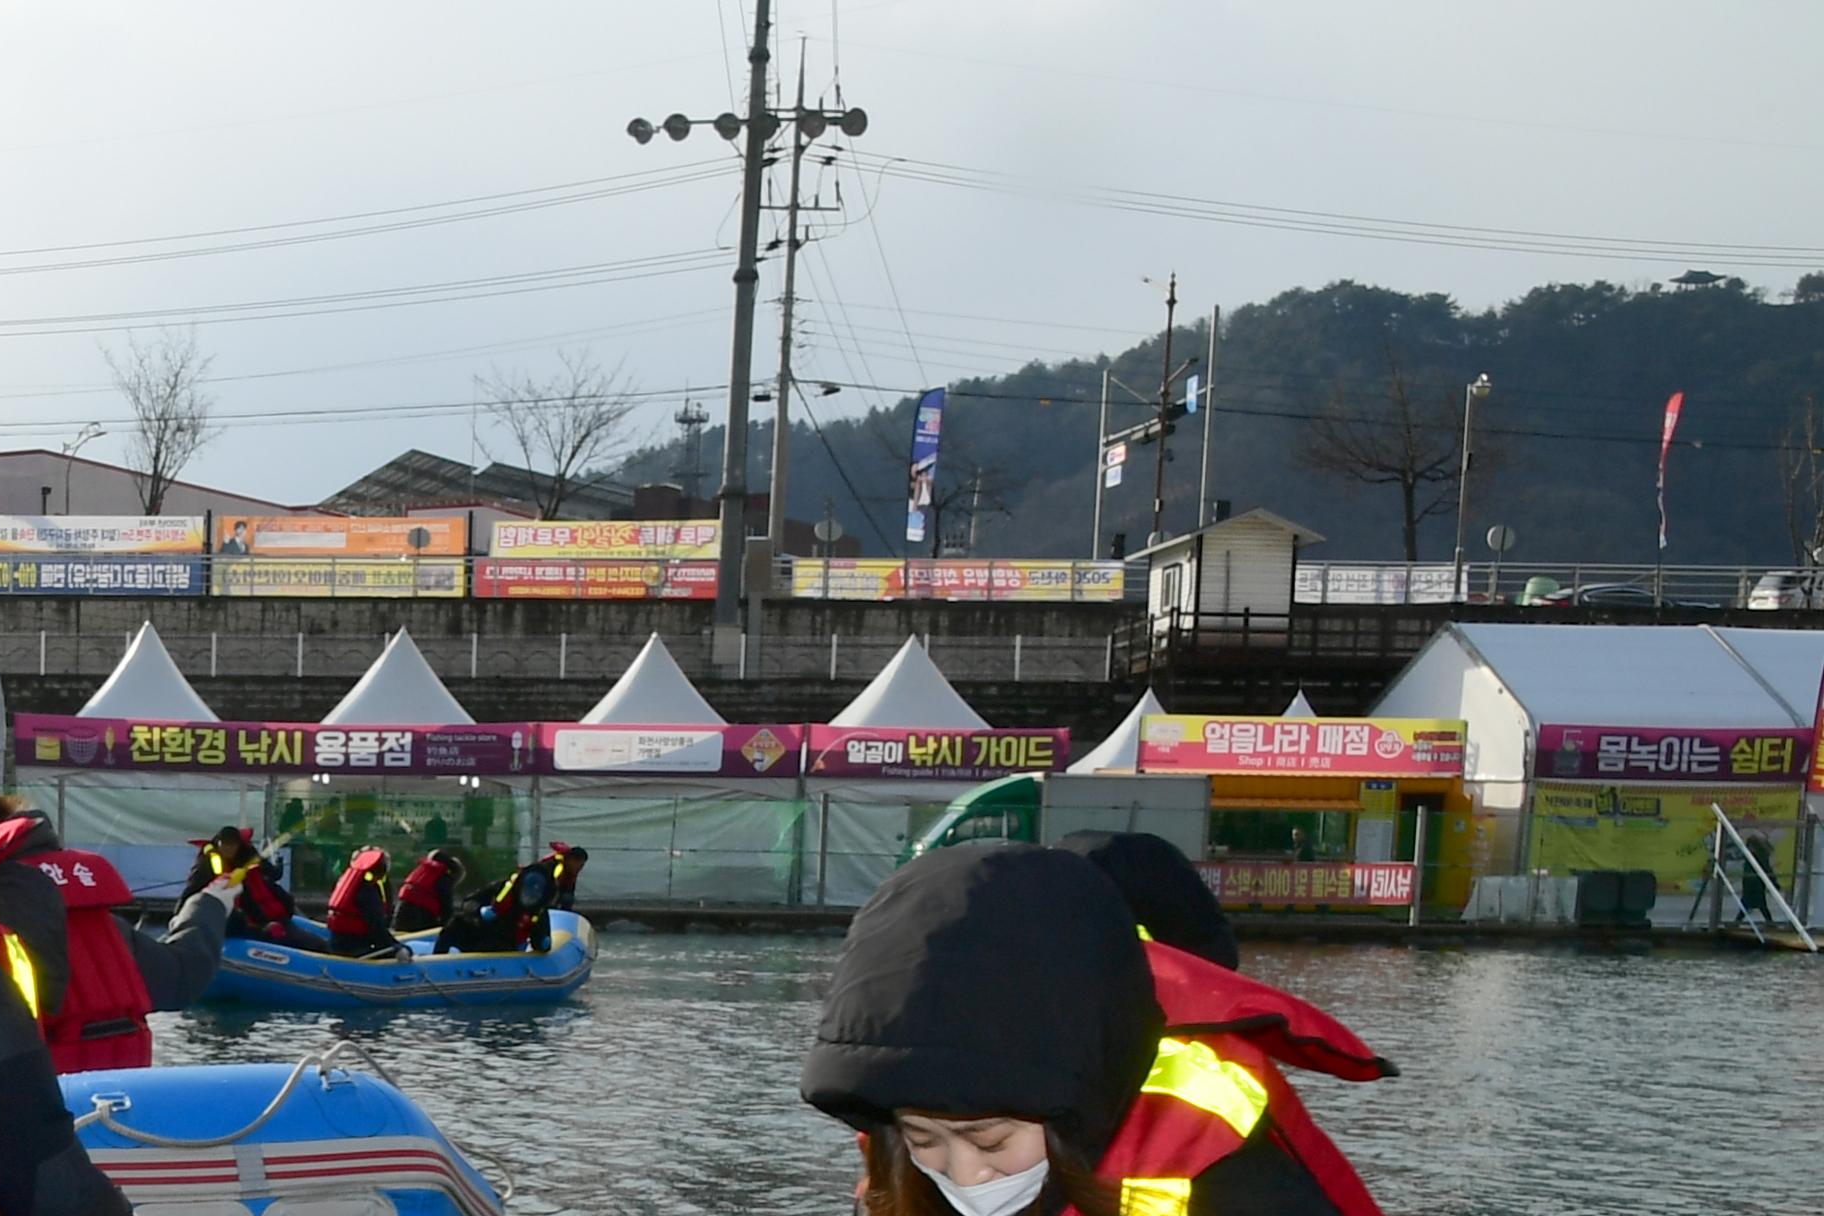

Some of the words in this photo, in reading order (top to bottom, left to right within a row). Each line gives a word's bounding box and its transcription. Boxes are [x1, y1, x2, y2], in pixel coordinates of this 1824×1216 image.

[129, 725, 226, 764] 친환경
[238, 730, 302, 766] 낚시
[313, 730, 413, 768] 용품점
[908, 735, 963, 767] 낚시
[971, 735, 1054, 768] 가이드
[1203, 722, 1310, 756] 얼음나라
[1318, 723, 1370, 756] 매점
[1597, 735, 1721, 773] 몸녹이는
[1730, 737, 1794, 775] 쉼터
[1239, 756, 1264, 769] Shop
